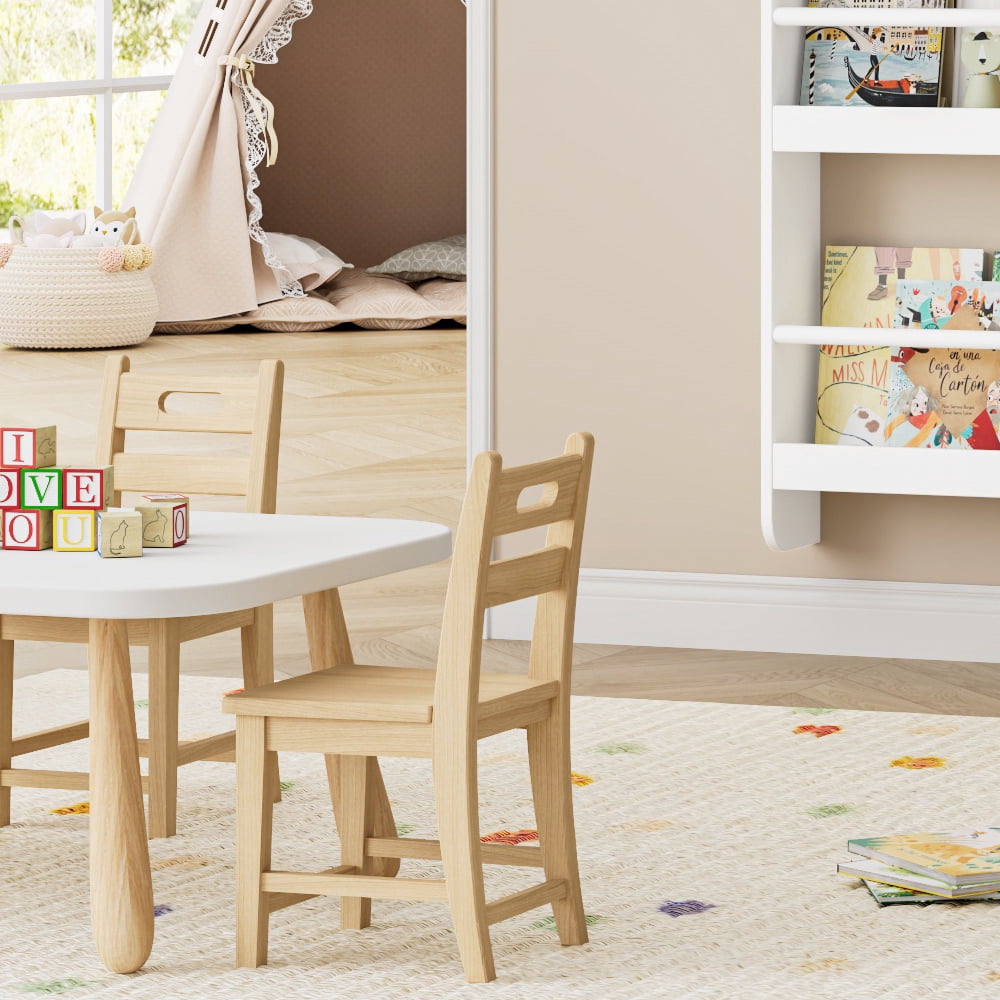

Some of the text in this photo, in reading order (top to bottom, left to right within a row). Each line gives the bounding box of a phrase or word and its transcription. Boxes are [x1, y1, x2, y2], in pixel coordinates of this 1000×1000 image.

[952, 359, 965, 374] de
[963, 351, 982, 360] una
[832, 360, 865, 383] MISS
[940, 371, 987, 398] Cartón
[12, 434, 25, 463] I
